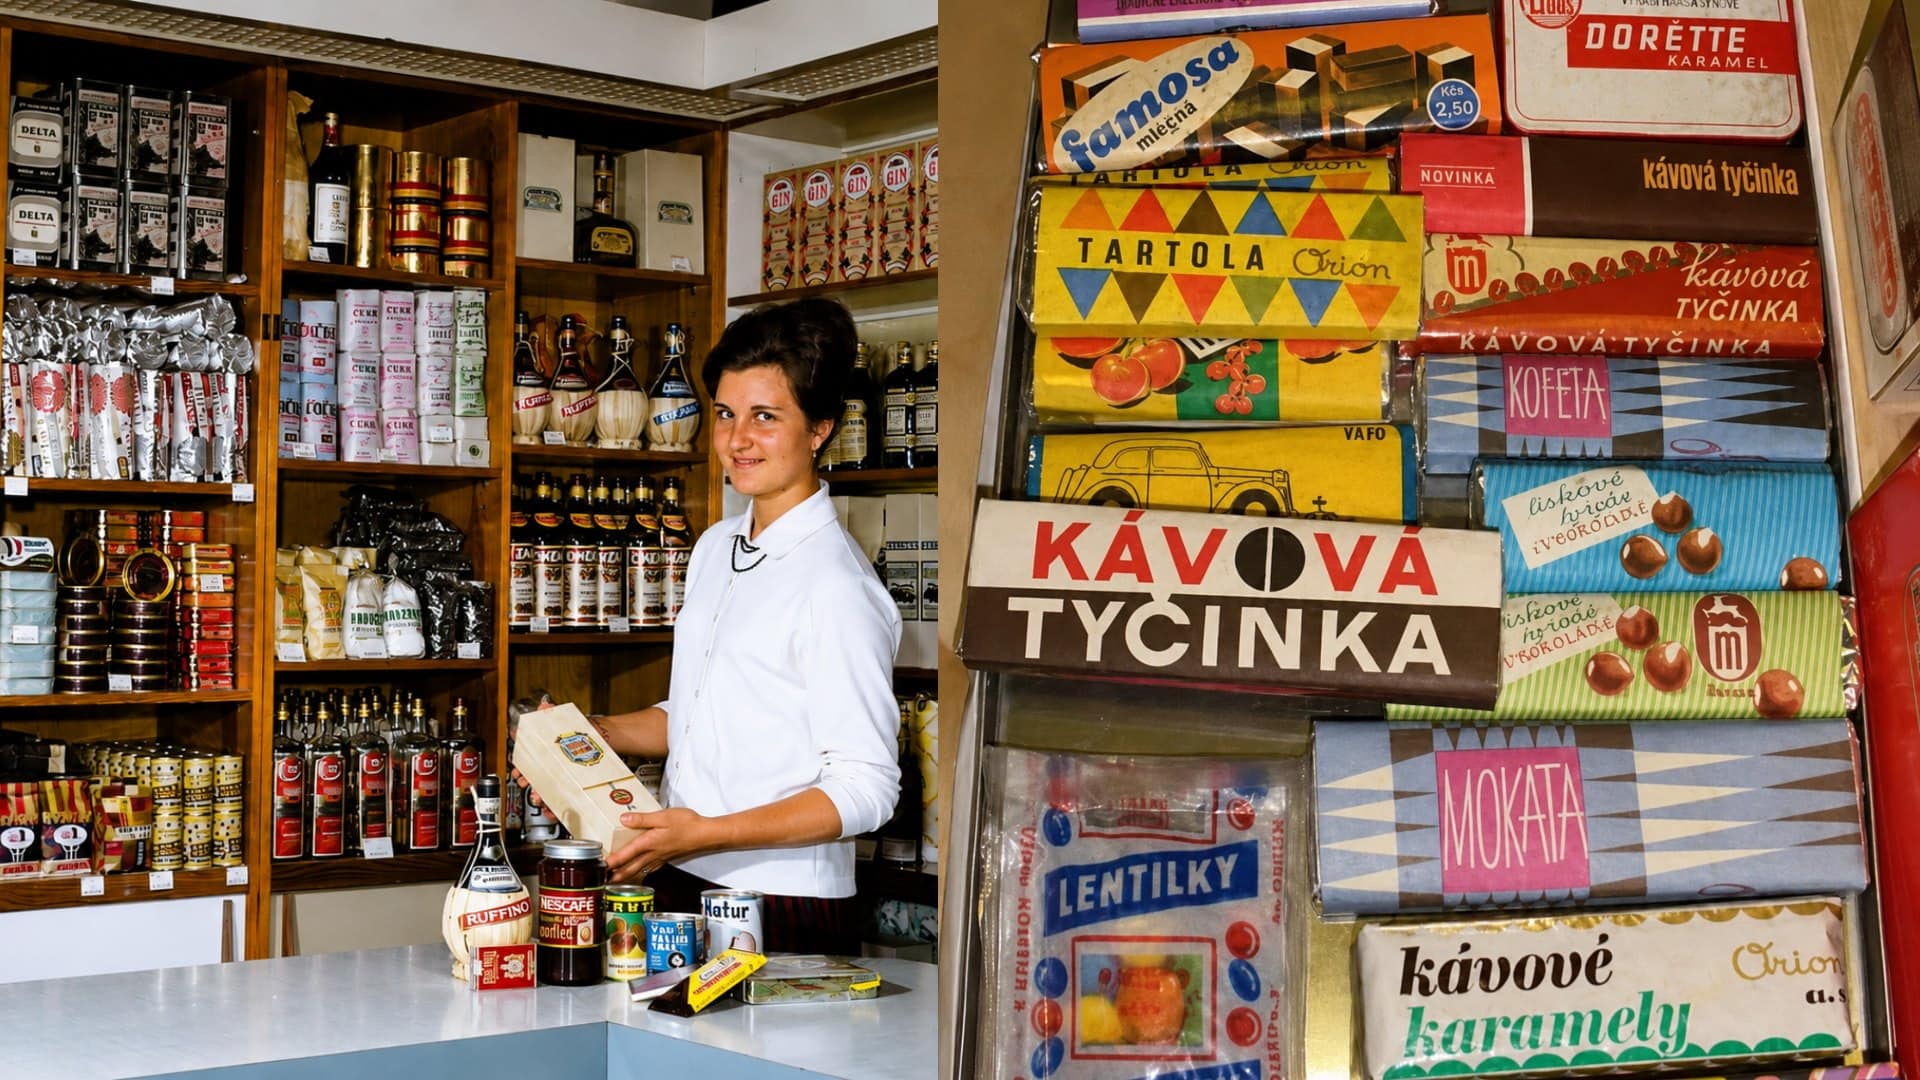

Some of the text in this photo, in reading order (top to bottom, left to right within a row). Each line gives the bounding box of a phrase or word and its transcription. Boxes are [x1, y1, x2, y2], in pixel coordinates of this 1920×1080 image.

[1668, 54, 1768, 69] KARAMEL
[1061, 39, 1240, 172] famosa
[1440, 85, 1464, 98] Kčs
[1436, 100, 1473, 118] 2,50
[21, 125, 56, 137] DELTA
[1136, 99, 1198, 152] mléčná
[848, 175, 868, 193] GIN
[887, 167, 907, 185] GIN
[1420, 168, 1496, 186] NOVINKA
[1643, 156, 1799, 197] kávová tyčinka
[772, 191, 790, 208] GIN
[808, 184, 828, 201] GIN
[19, 210, 54, 221] DELTA
[1078, 237, 1392, 280] TARTOLA Orion
[1682, 244, 1810, 289] kávová
[1676, 290, 1800, 322] TYČINKA
[1459, 329, 1772, 355] KÁVOVÁ TYČINKA
[1508, 366, 1607, 424] KOFETA
[1344, 427, 1386, 441] VAFO
[1032, 511, 1439, 596] KÁVOVÁ
[1503, 593, 1582, 629] iskové
[1008, 592, 1451, 675] TYČINKA
[1444, 763, 1589, 870] MOKATA
[1059, 853, 1239, 917] LENTILKY
[467, 901, 529, 926] RUFFINO
[541, 896, 595, 912] NESCAFÉ
[705, 898, 749, 919] Natur
[1400, 932, 1614, 996] kávové
[1732, 942, 1844, 981] Orion
[1403, 990, 1691, 1058] karamely
